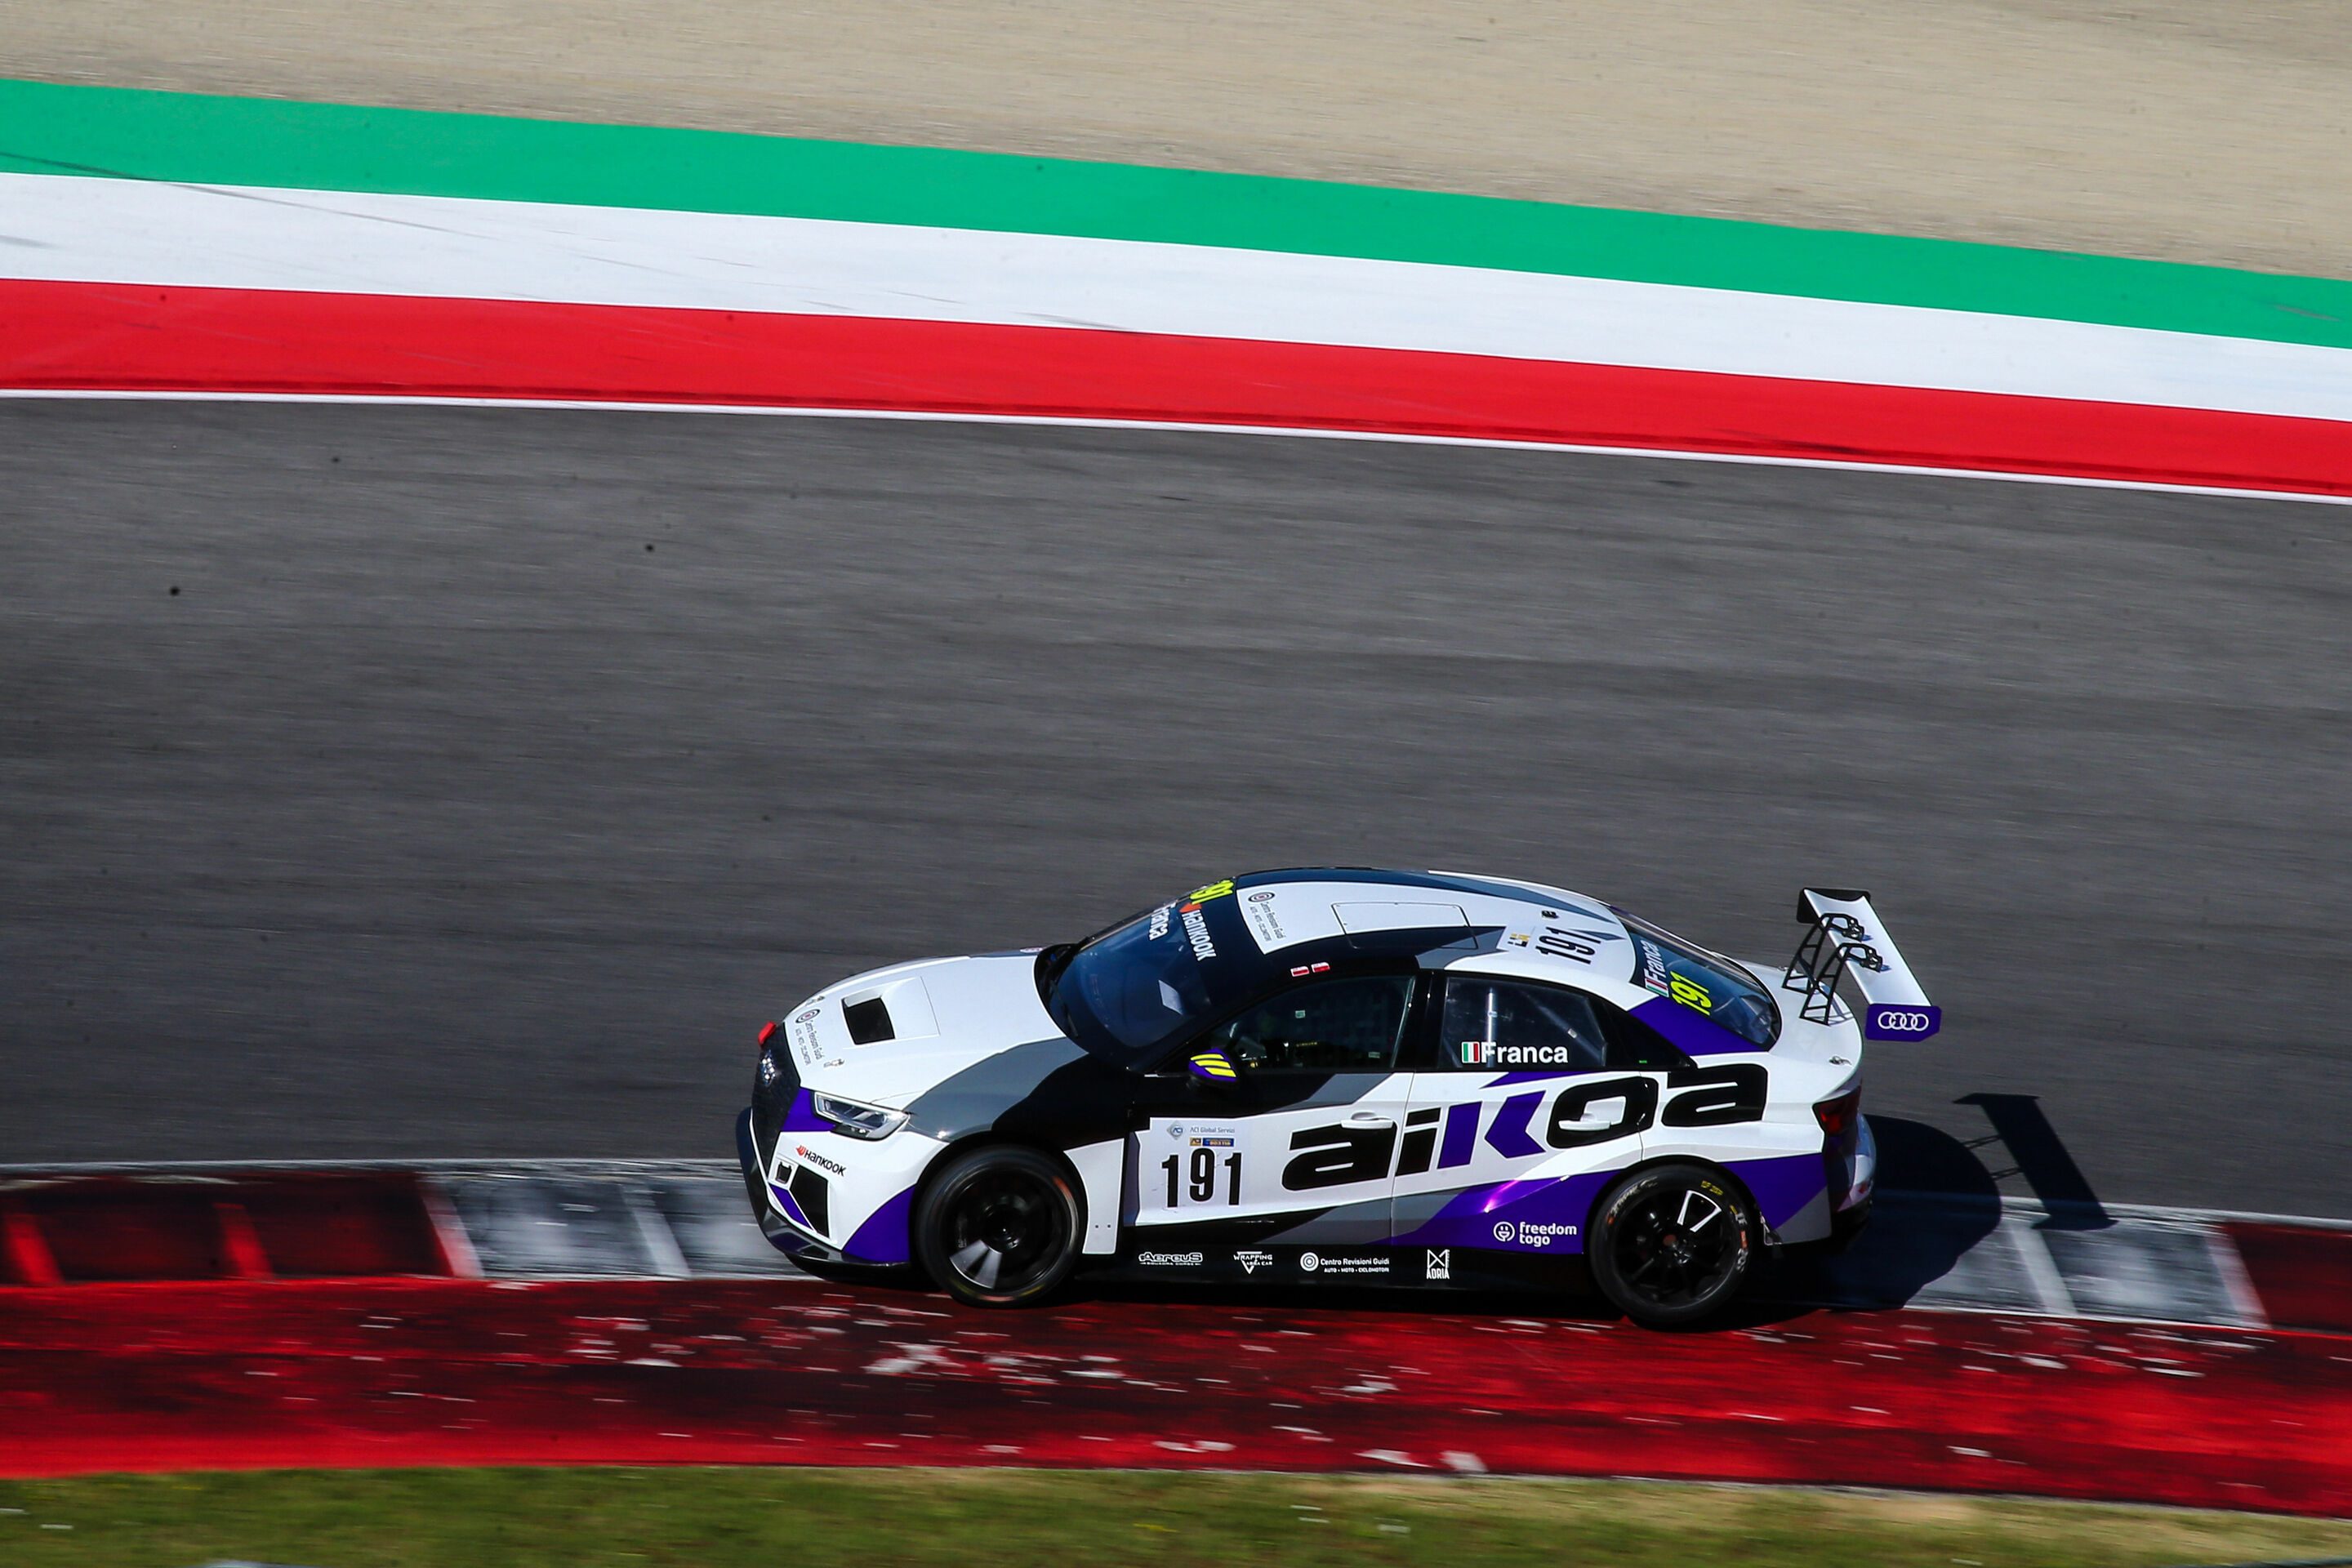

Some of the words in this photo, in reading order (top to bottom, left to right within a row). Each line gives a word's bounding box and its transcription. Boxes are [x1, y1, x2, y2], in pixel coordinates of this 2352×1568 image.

[1535, 927, 1601, 964] 191
[1640, 939, 1668, 985] Franca
[1670, 971, 1713, 1015] 191
[1481, 1041, 1569, 1063] Franca
[1161, 1147, 1242, 1208] 191
[1519, 1221, 1578, 1235] freedom
[1519, 1233, 1551, 1248] togo
[1320, 1258, 1342, 1266] Centro
[1343, 1258, 1372, 1266] Revisioni
[1426, 1267, 1450, 1280] ADRIA
